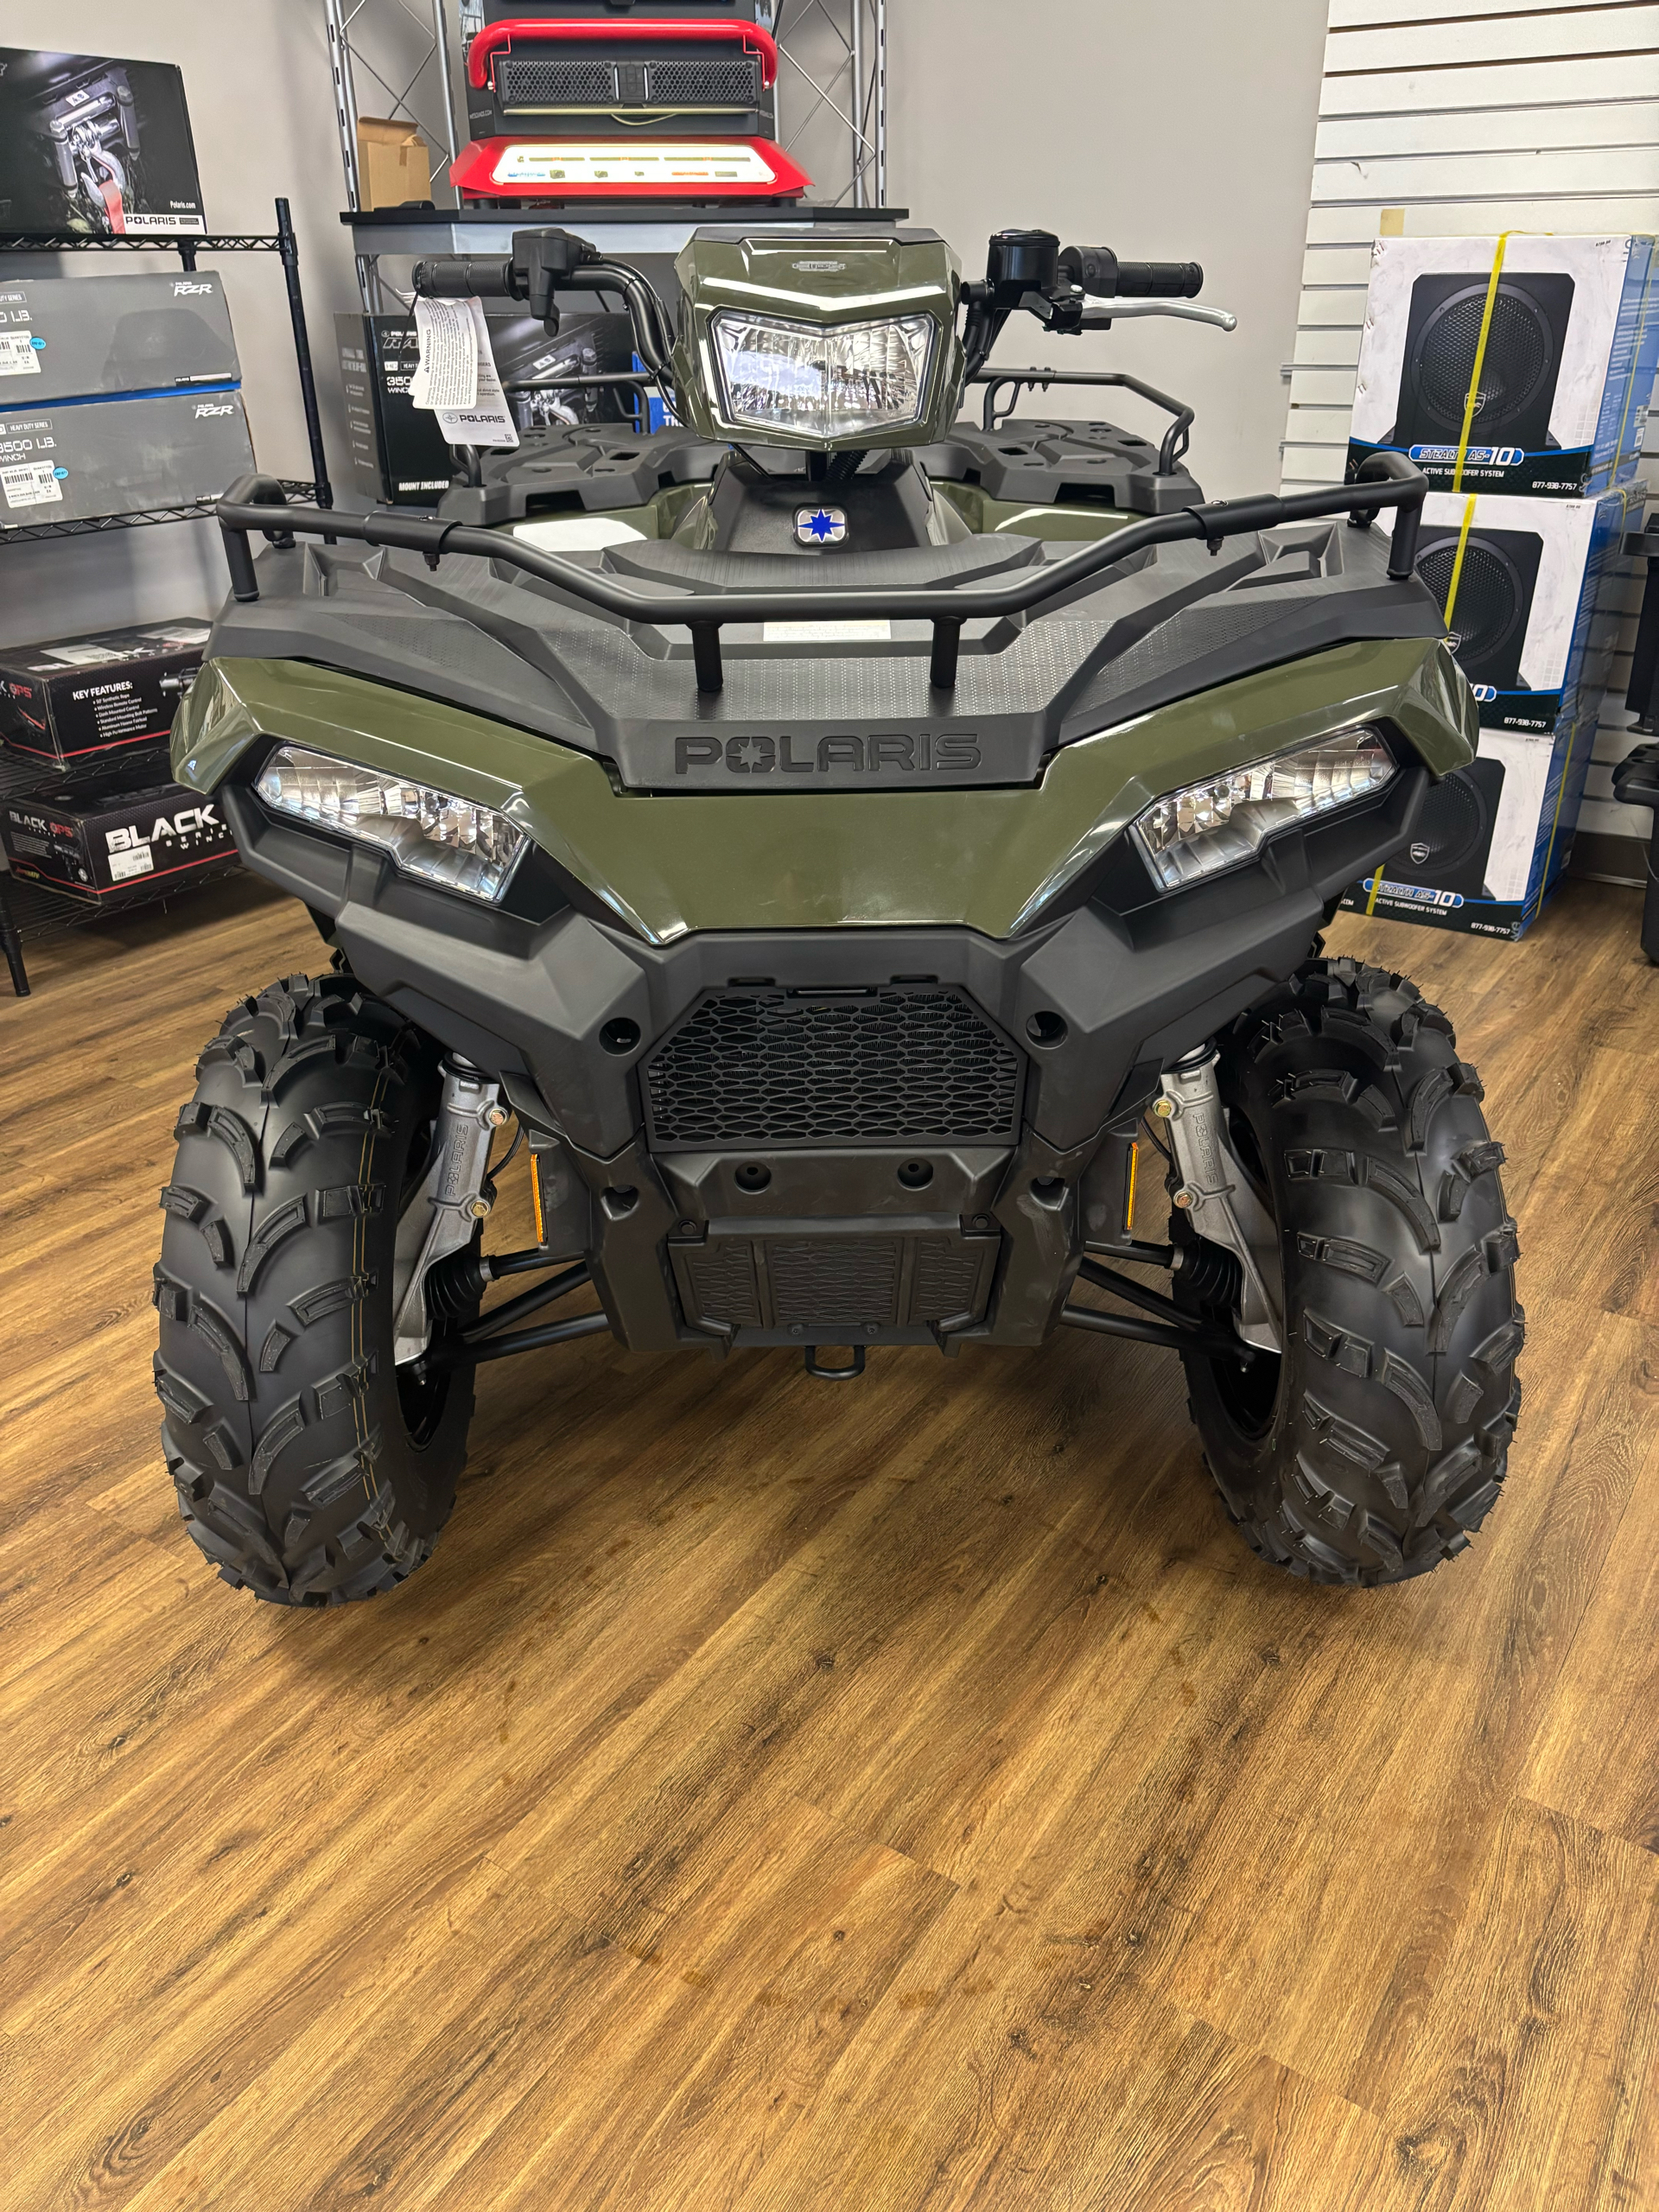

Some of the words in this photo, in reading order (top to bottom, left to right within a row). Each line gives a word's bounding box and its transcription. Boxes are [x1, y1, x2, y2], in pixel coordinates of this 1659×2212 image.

[169, 200, 196, 209] Polaris.com
[125, 216, 176, 225] POLARIS
[174, 283, 213, 297] RZR
[10, 310, 33, 322] LB.
[386, 376, 412, 386] 350
[195, 404, 234, 419] RZR
[36, 436, 57, 449] LB.
[1419, 448, 1466, 461] STEALT
[1467, 447, 1515, 466] AS-10
[1444, 467, 1479, 477] SUBOFER
[398, 481, 420, 491] MOUNT
[420, 480, 449, 490] INCLUDED
[1532, 481, 1577, 491] 877-938-7757
[73, 689, 90, 701] KEY
[90, 681, 133, 697] FEATURES:
[1503, 716, 1547, 728] 877-938-7757
[674, 733, 982, 775] POLARIS
[9, 810, 48, 831] BLACK
[105, 804, 220, 854] BLACK
[165, 823, 227, 848] SERIE
[1414, 889, 1457, 907] AS-10
[1375, 897, 1394, 906] ACTIVE
[1394, 900, 1426, 912] SUBWOOFER
[1426, 906, 1447, 916] SYSTEM
[1192, 1113, 1218, 1185] POLARIS
[445, 1124, 469, 1196] POLARIS
